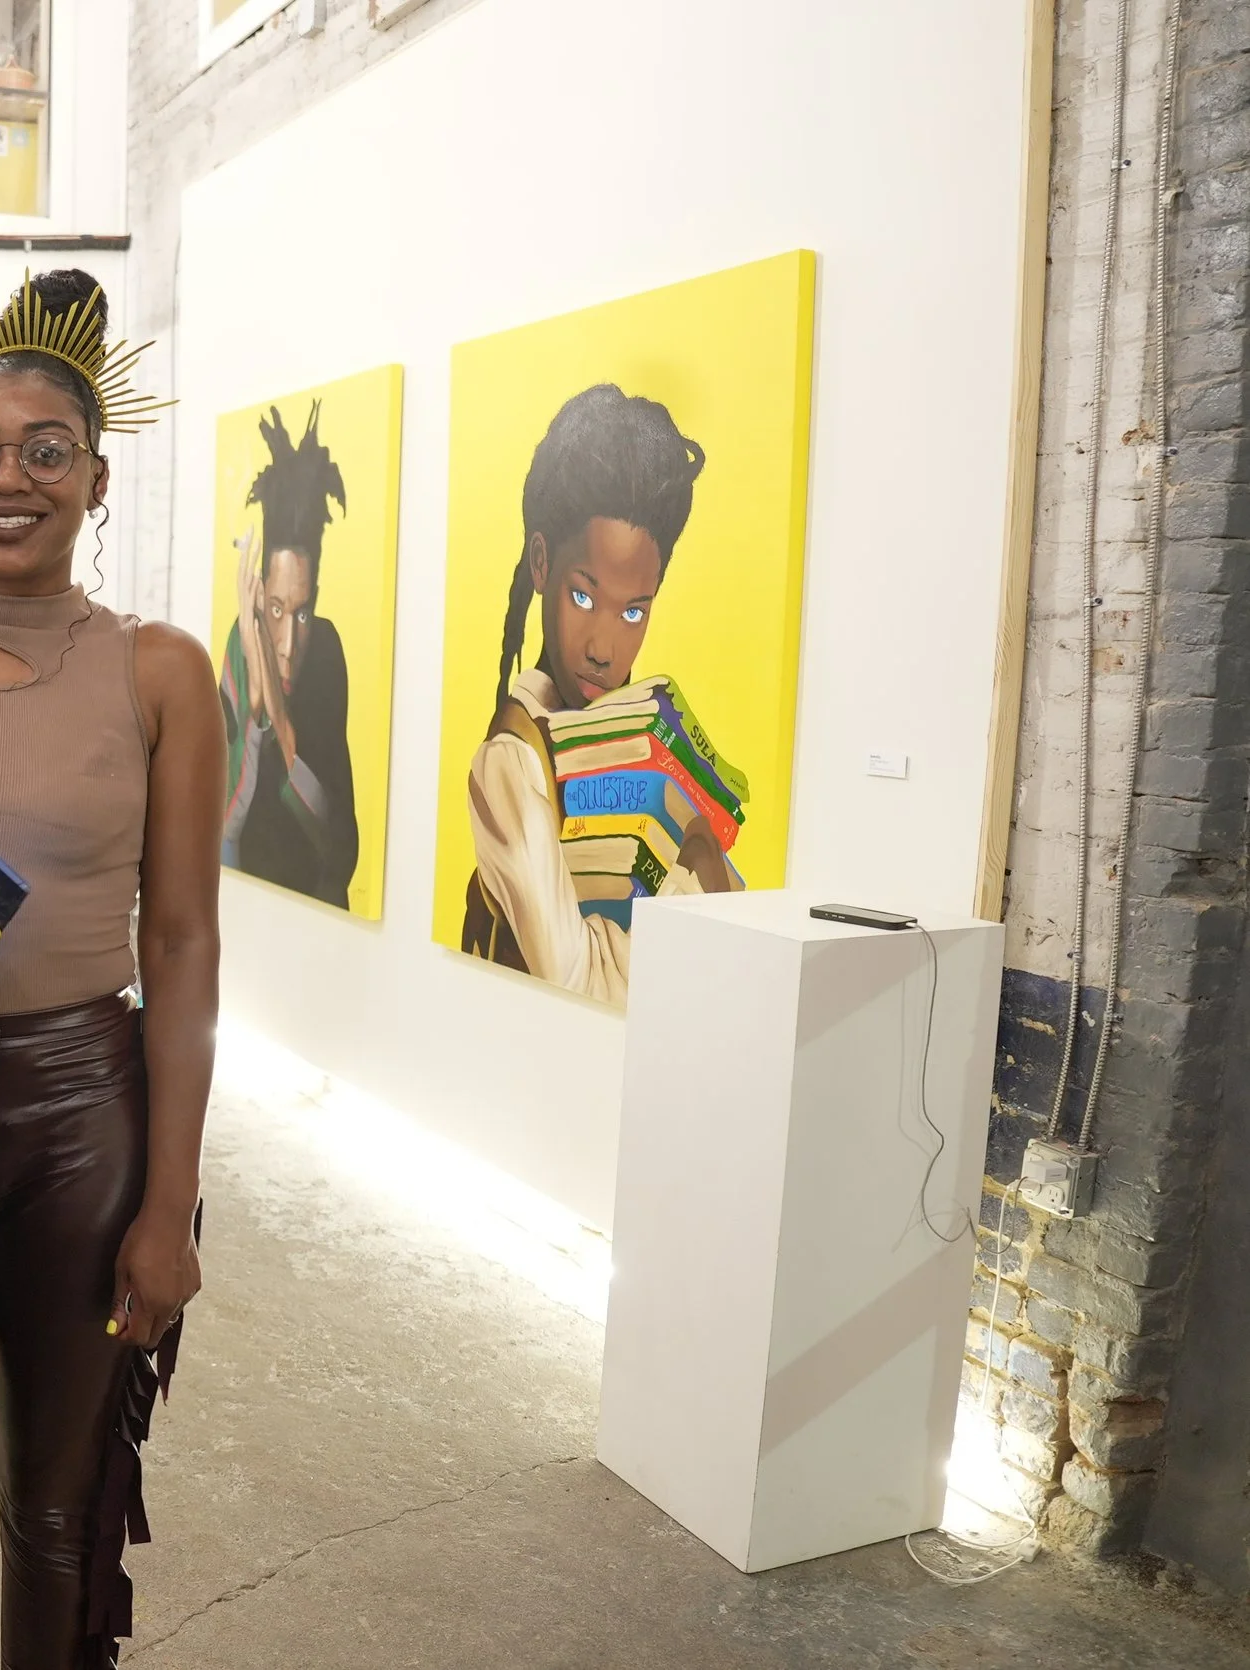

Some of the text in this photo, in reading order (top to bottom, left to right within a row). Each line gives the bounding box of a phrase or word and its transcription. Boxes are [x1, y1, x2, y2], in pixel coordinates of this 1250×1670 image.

[691, 725, 716, 768] SULA
[657, 752, 685, 781] Love
[577, 776, 624, 811] BLUEST
[623, 780, 648, 812] EYE
